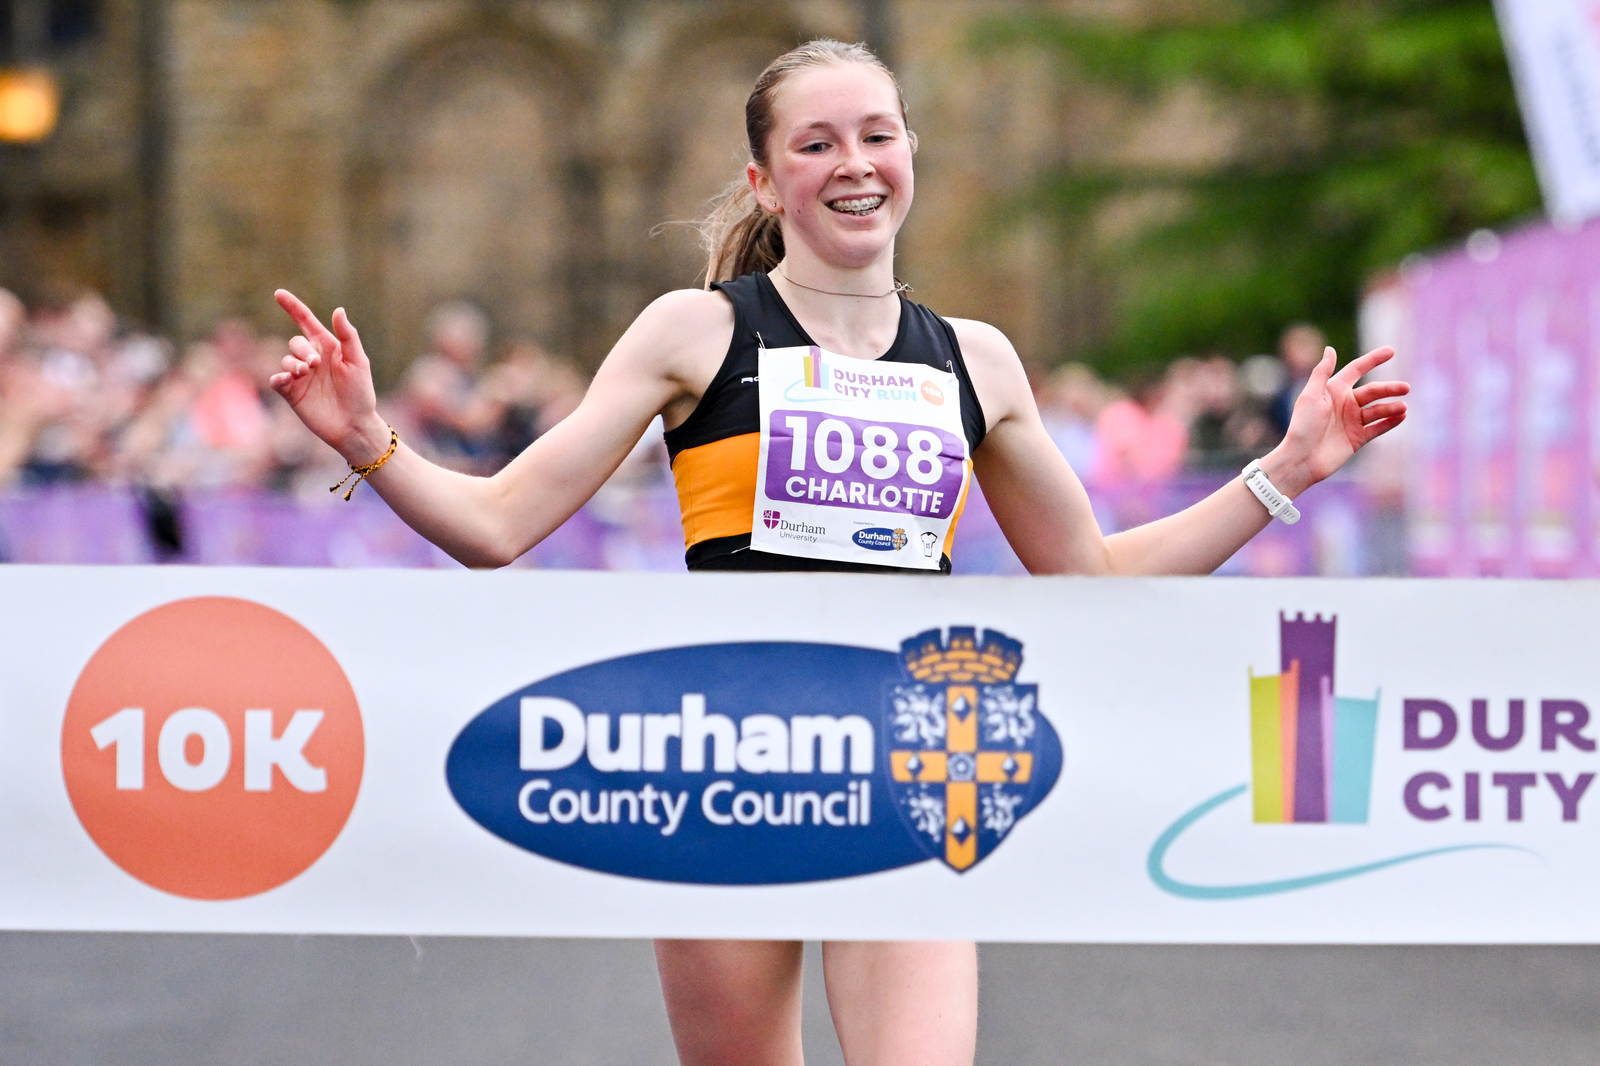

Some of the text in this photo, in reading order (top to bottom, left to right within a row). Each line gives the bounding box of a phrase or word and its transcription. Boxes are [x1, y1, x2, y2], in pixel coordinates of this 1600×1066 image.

[833, 368, 915, 388] DURHAM
[834, 382, 917, 402] CITY RUN
[922, 386, 943, 399] 10K
[785, 415, 944, 485] 1088
[785, 476, 944, 514] CHARLOTTE
[780, 520, 826, 535] Durham
[780, 531, 818, 543] University
[858, 531, 892, 542] Durham
[518, 694, 876, 774] Durham
[1403, 698, 1598, 752] DUR
[89, 707, 328, 793] 10K
[517, 780, 871, 836] County Council
[1403, 770, 1597, 822] CITY
